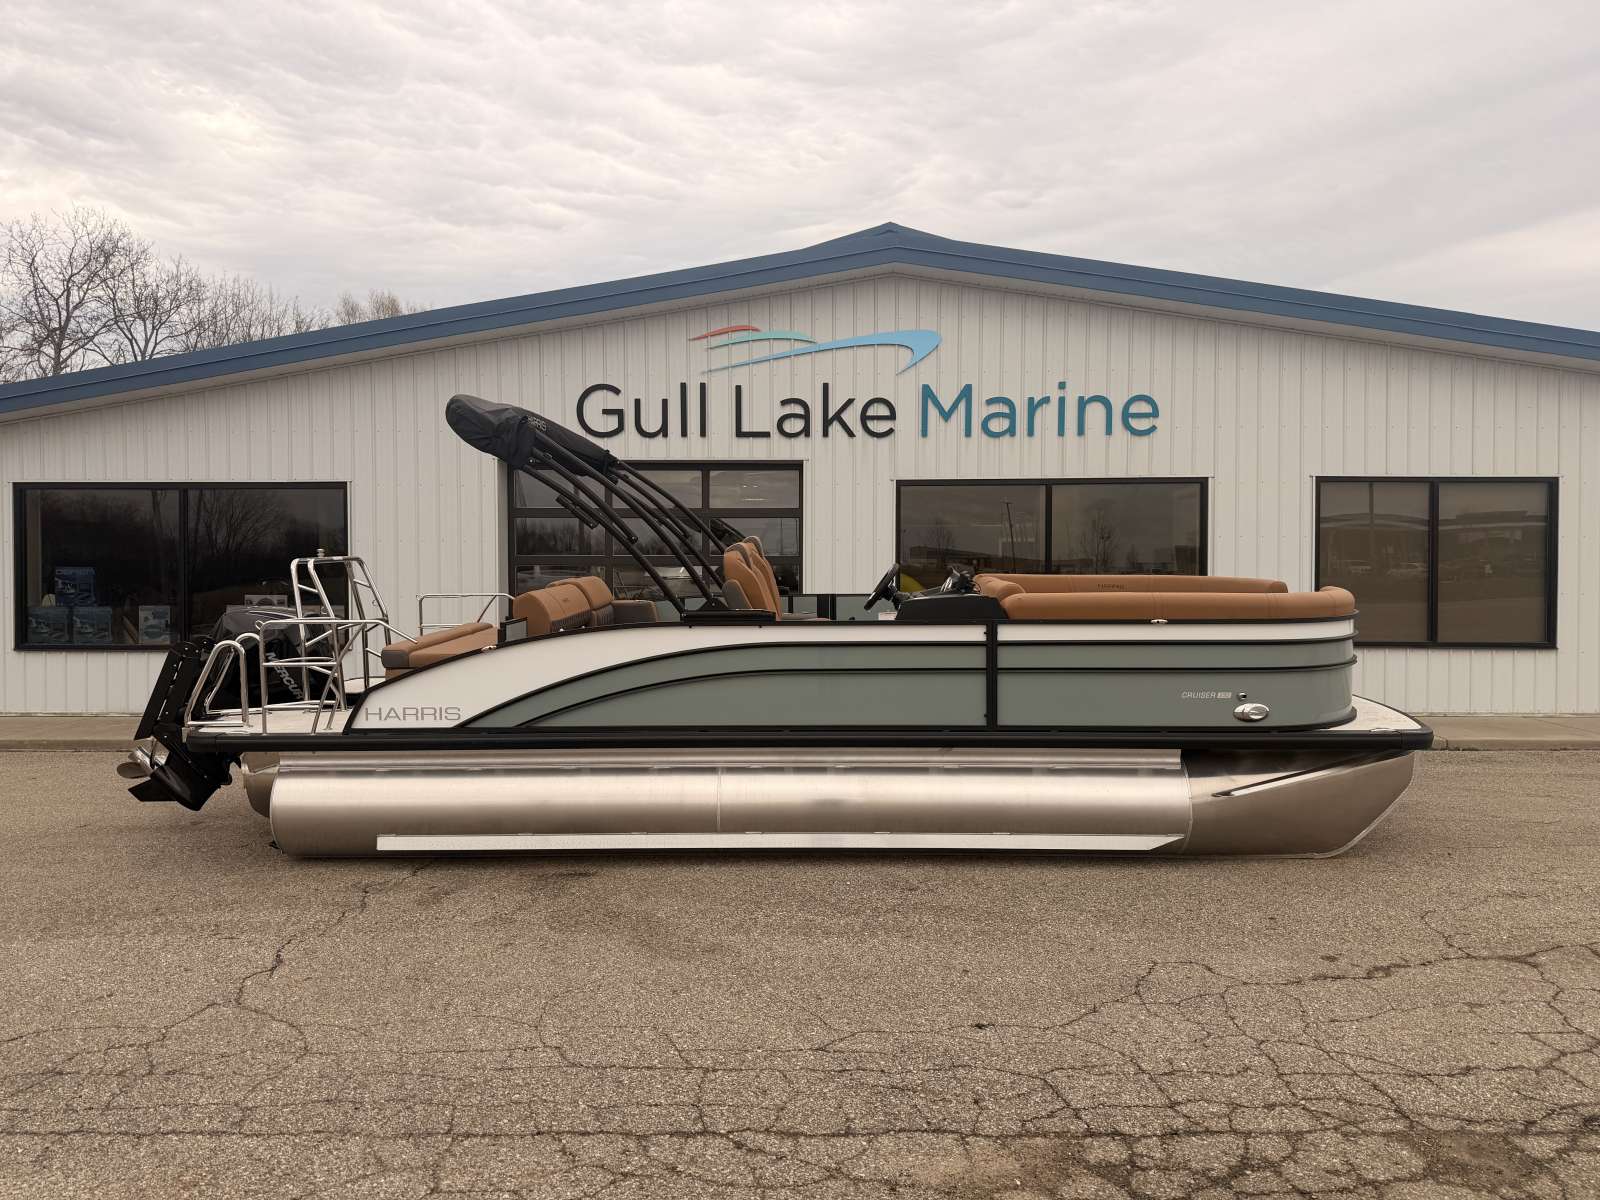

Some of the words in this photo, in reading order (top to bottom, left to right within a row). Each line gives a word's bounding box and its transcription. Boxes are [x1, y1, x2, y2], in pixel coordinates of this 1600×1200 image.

[576, 382, 706, 438] Gull
[736, 383, 896, 438] Lake
[922, 382, 1159, 437] Marine
[265, 652, 304, 699] MERCUR
[1181, 691, 1217, 699] CRUISER
[364, 706, 460, 720] HARRIS
